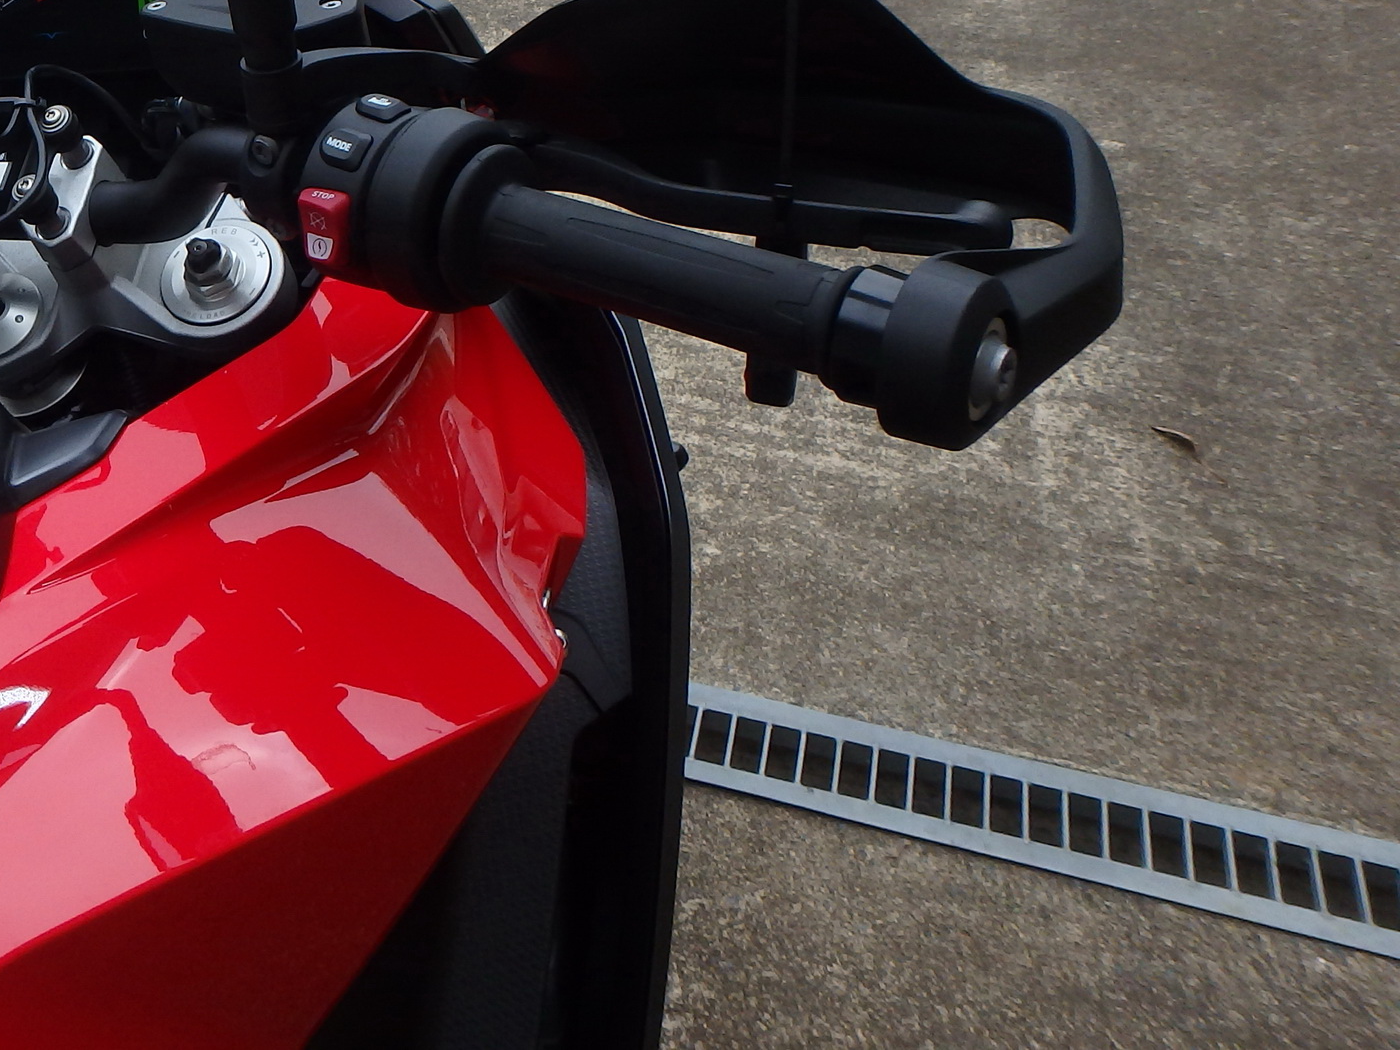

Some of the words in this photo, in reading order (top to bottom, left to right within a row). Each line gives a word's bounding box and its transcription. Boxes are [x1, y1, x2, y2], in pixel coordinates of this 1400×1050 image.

[326, 137, 353, 152] MODE
[311, 190, 335, 200] STOP
[211, 228, 238, 236] REB
